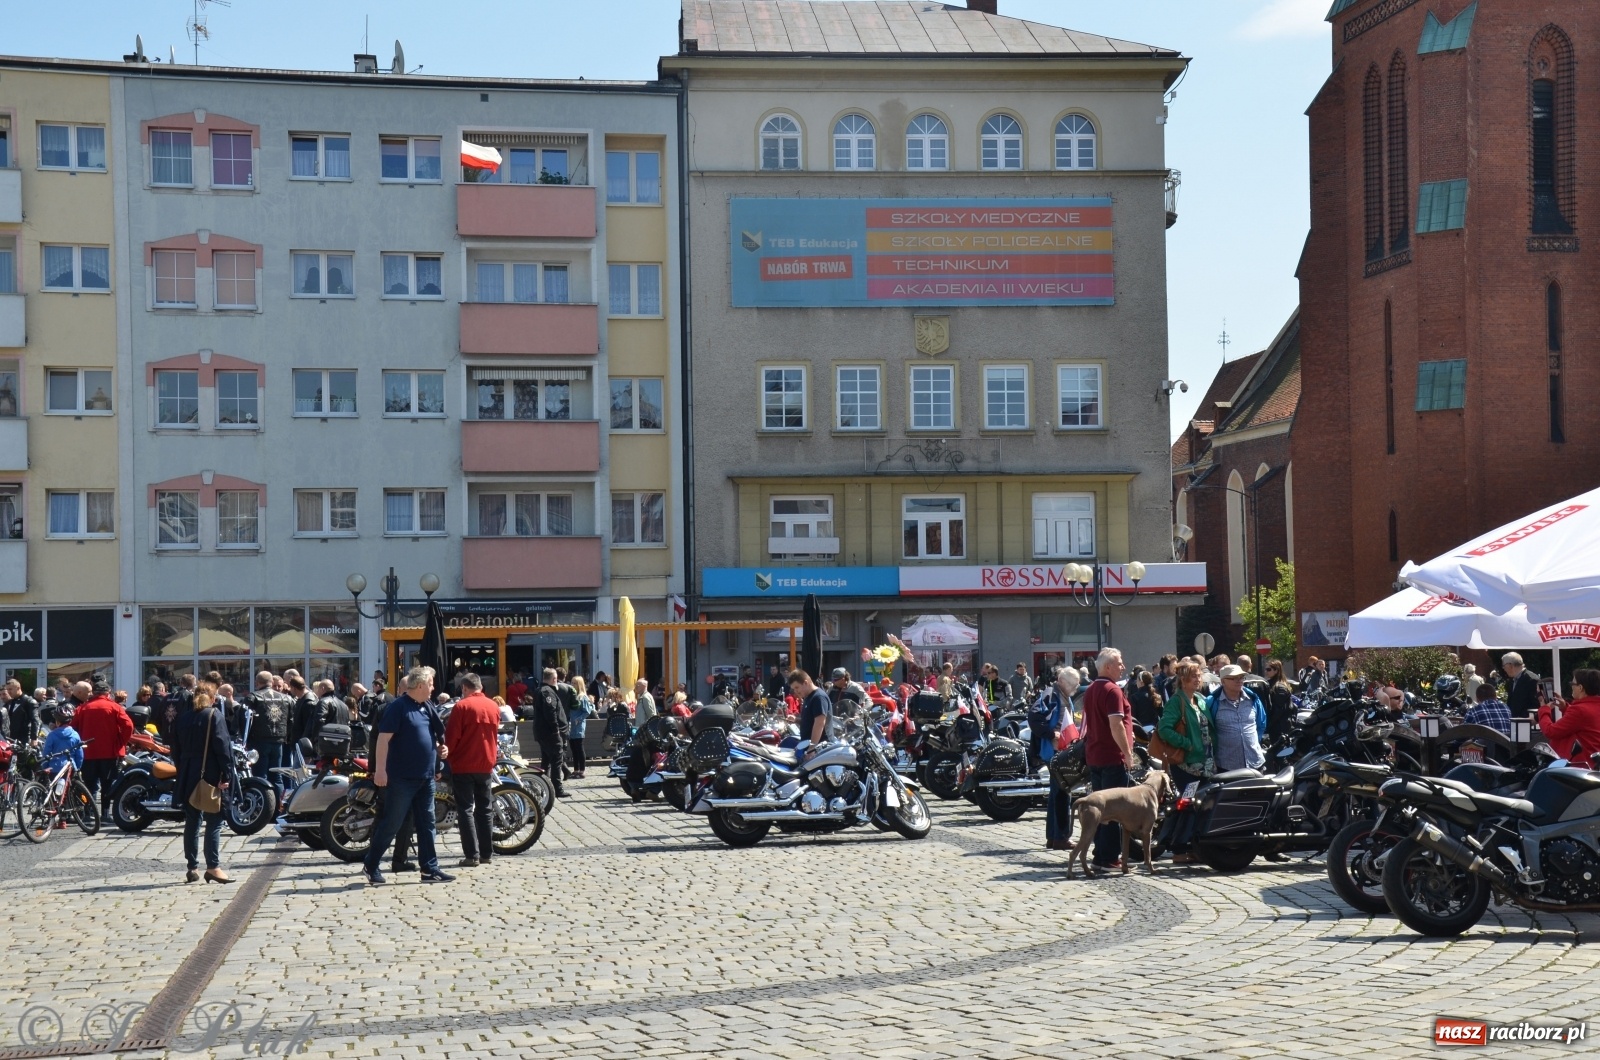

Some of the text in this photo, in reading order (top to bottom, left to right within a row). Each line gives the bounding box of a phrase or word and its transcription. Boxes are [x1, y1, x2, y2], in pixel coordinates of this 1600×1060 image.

[891, 212, 1081, 224] SZKOŁY MEDYCZNE
[769, 238, 858, 249] TEB Edukacja
[891, 235, 1093, 248] SZKOŁY POLICEALNE
[767, 260, 847, 275] NABÓR TRWA
[892, 259, 1009, 271] TECHNIKUM
[892, 282, 1084, 295] AKADEMIA III WIEKU
[1477, 506, 1580, 553] ŻYWIEC
[777, 578, 847, 588] TEB Edukacja
[982, 567, 1123, 587] ROSSMN
[312, 624, 356, 636] empik.com
[1546, 624, 1596, 636] ŻYWIEC
